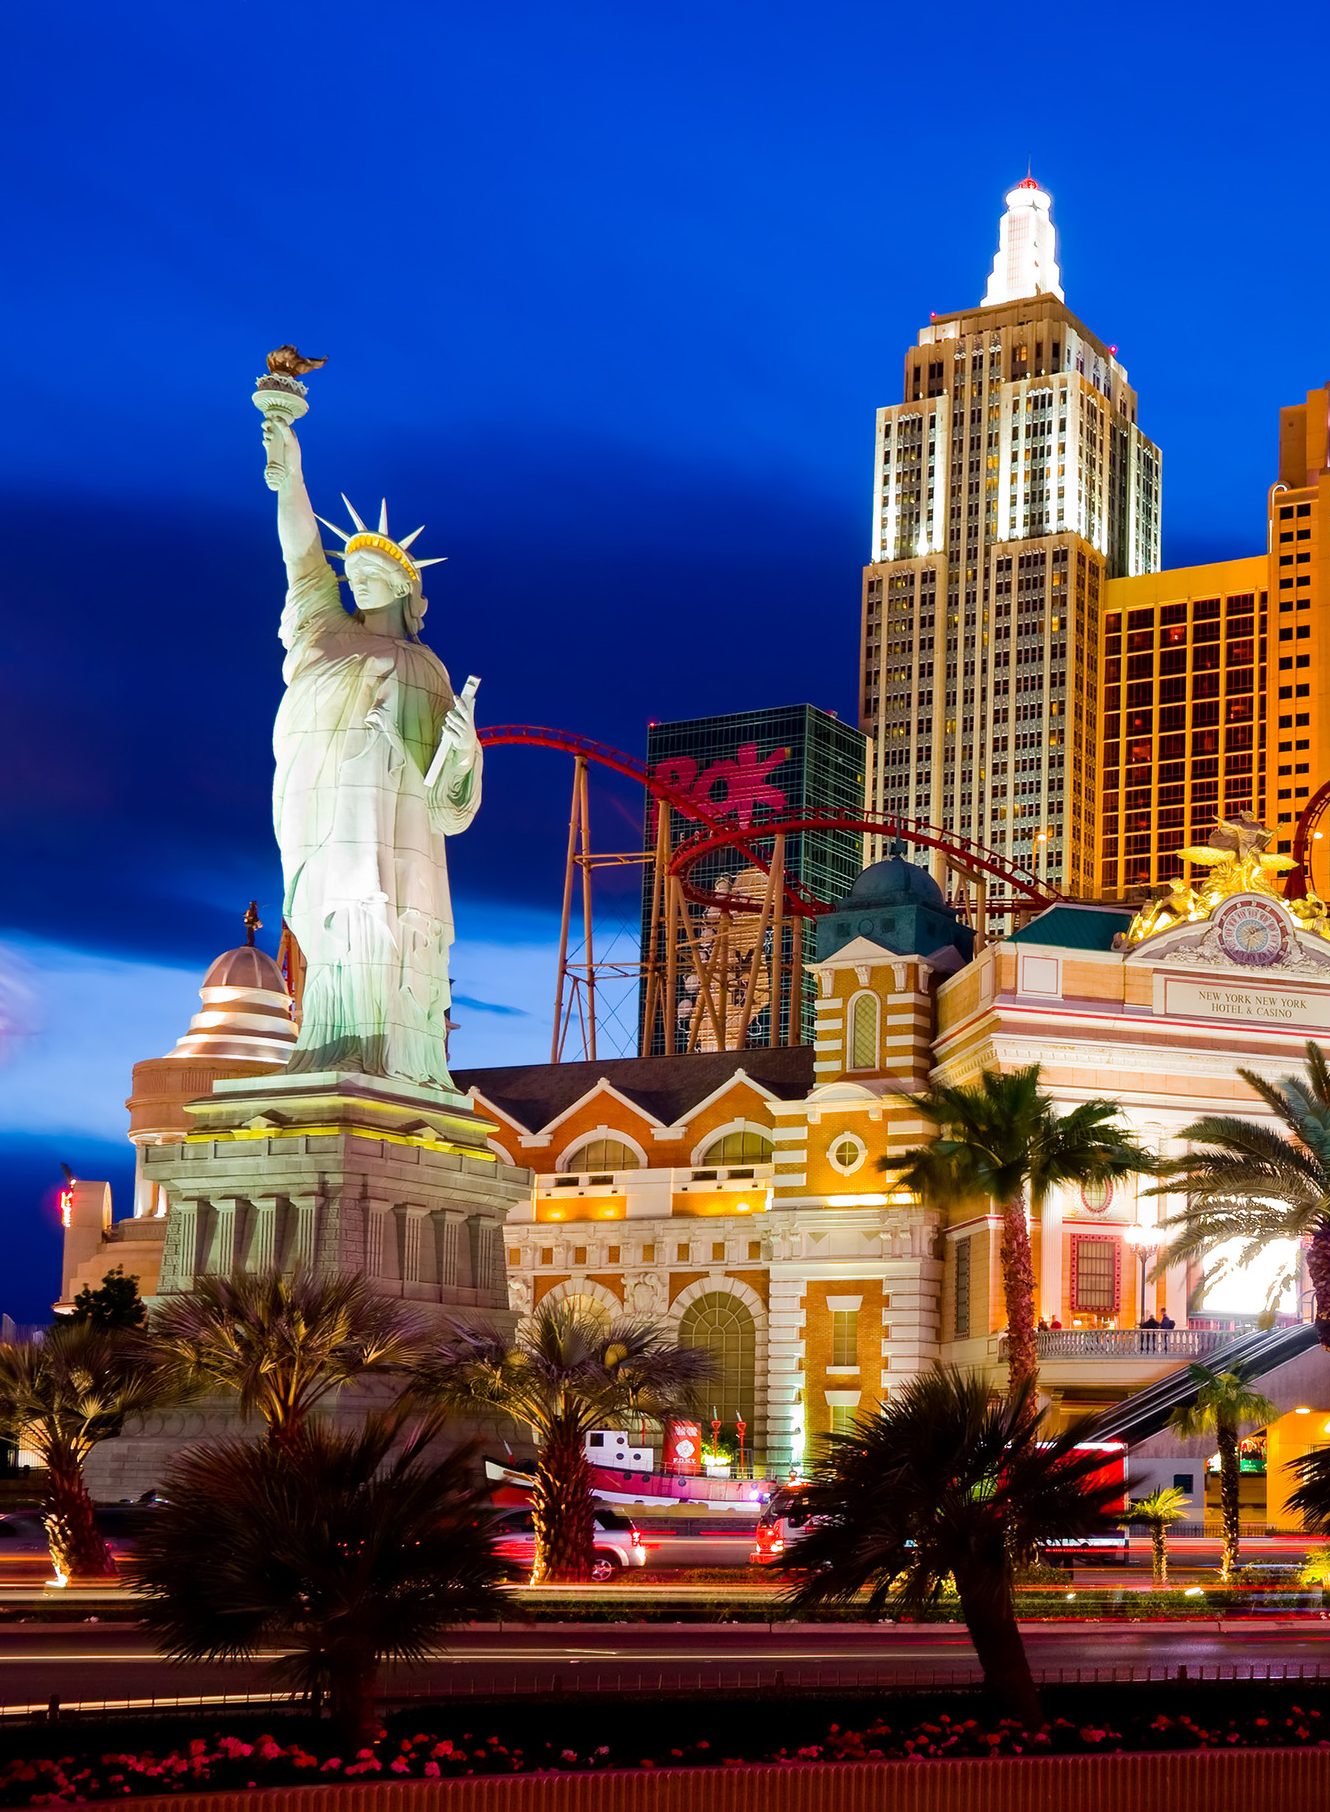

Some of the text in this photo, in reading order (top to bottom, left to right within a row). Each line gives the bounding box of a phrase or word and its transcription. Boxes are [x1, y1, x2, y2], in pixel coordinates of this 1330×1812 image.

[1199, 991, 1308, 1009] NEW YORK NEW YORK
[1211, 1003, 1243, 1014] HOTEL
[1256, 1007, 1292, 1018] CASINO
